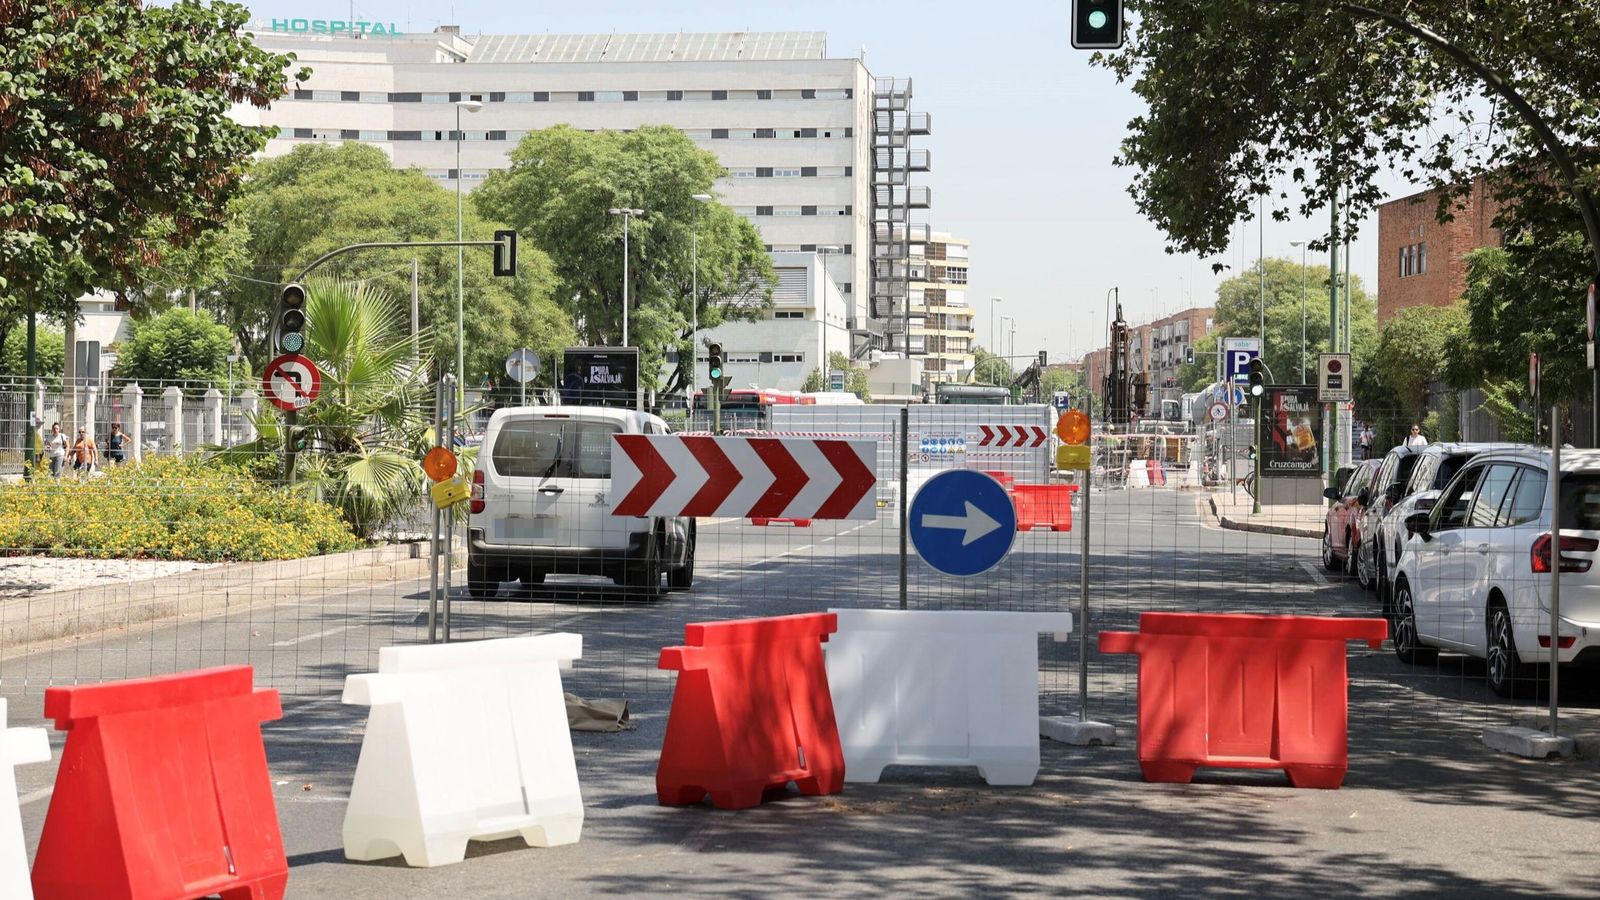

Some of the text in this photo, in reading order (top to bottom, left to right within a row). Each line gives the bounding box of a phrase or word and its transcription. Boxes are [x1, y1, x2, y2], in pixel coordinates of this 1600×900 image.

[272, 18, 404, 36] HOSPITAL
[1234, 352, 1250, 373] P
[1269, 460, 1312, 469] Cruzcampo
